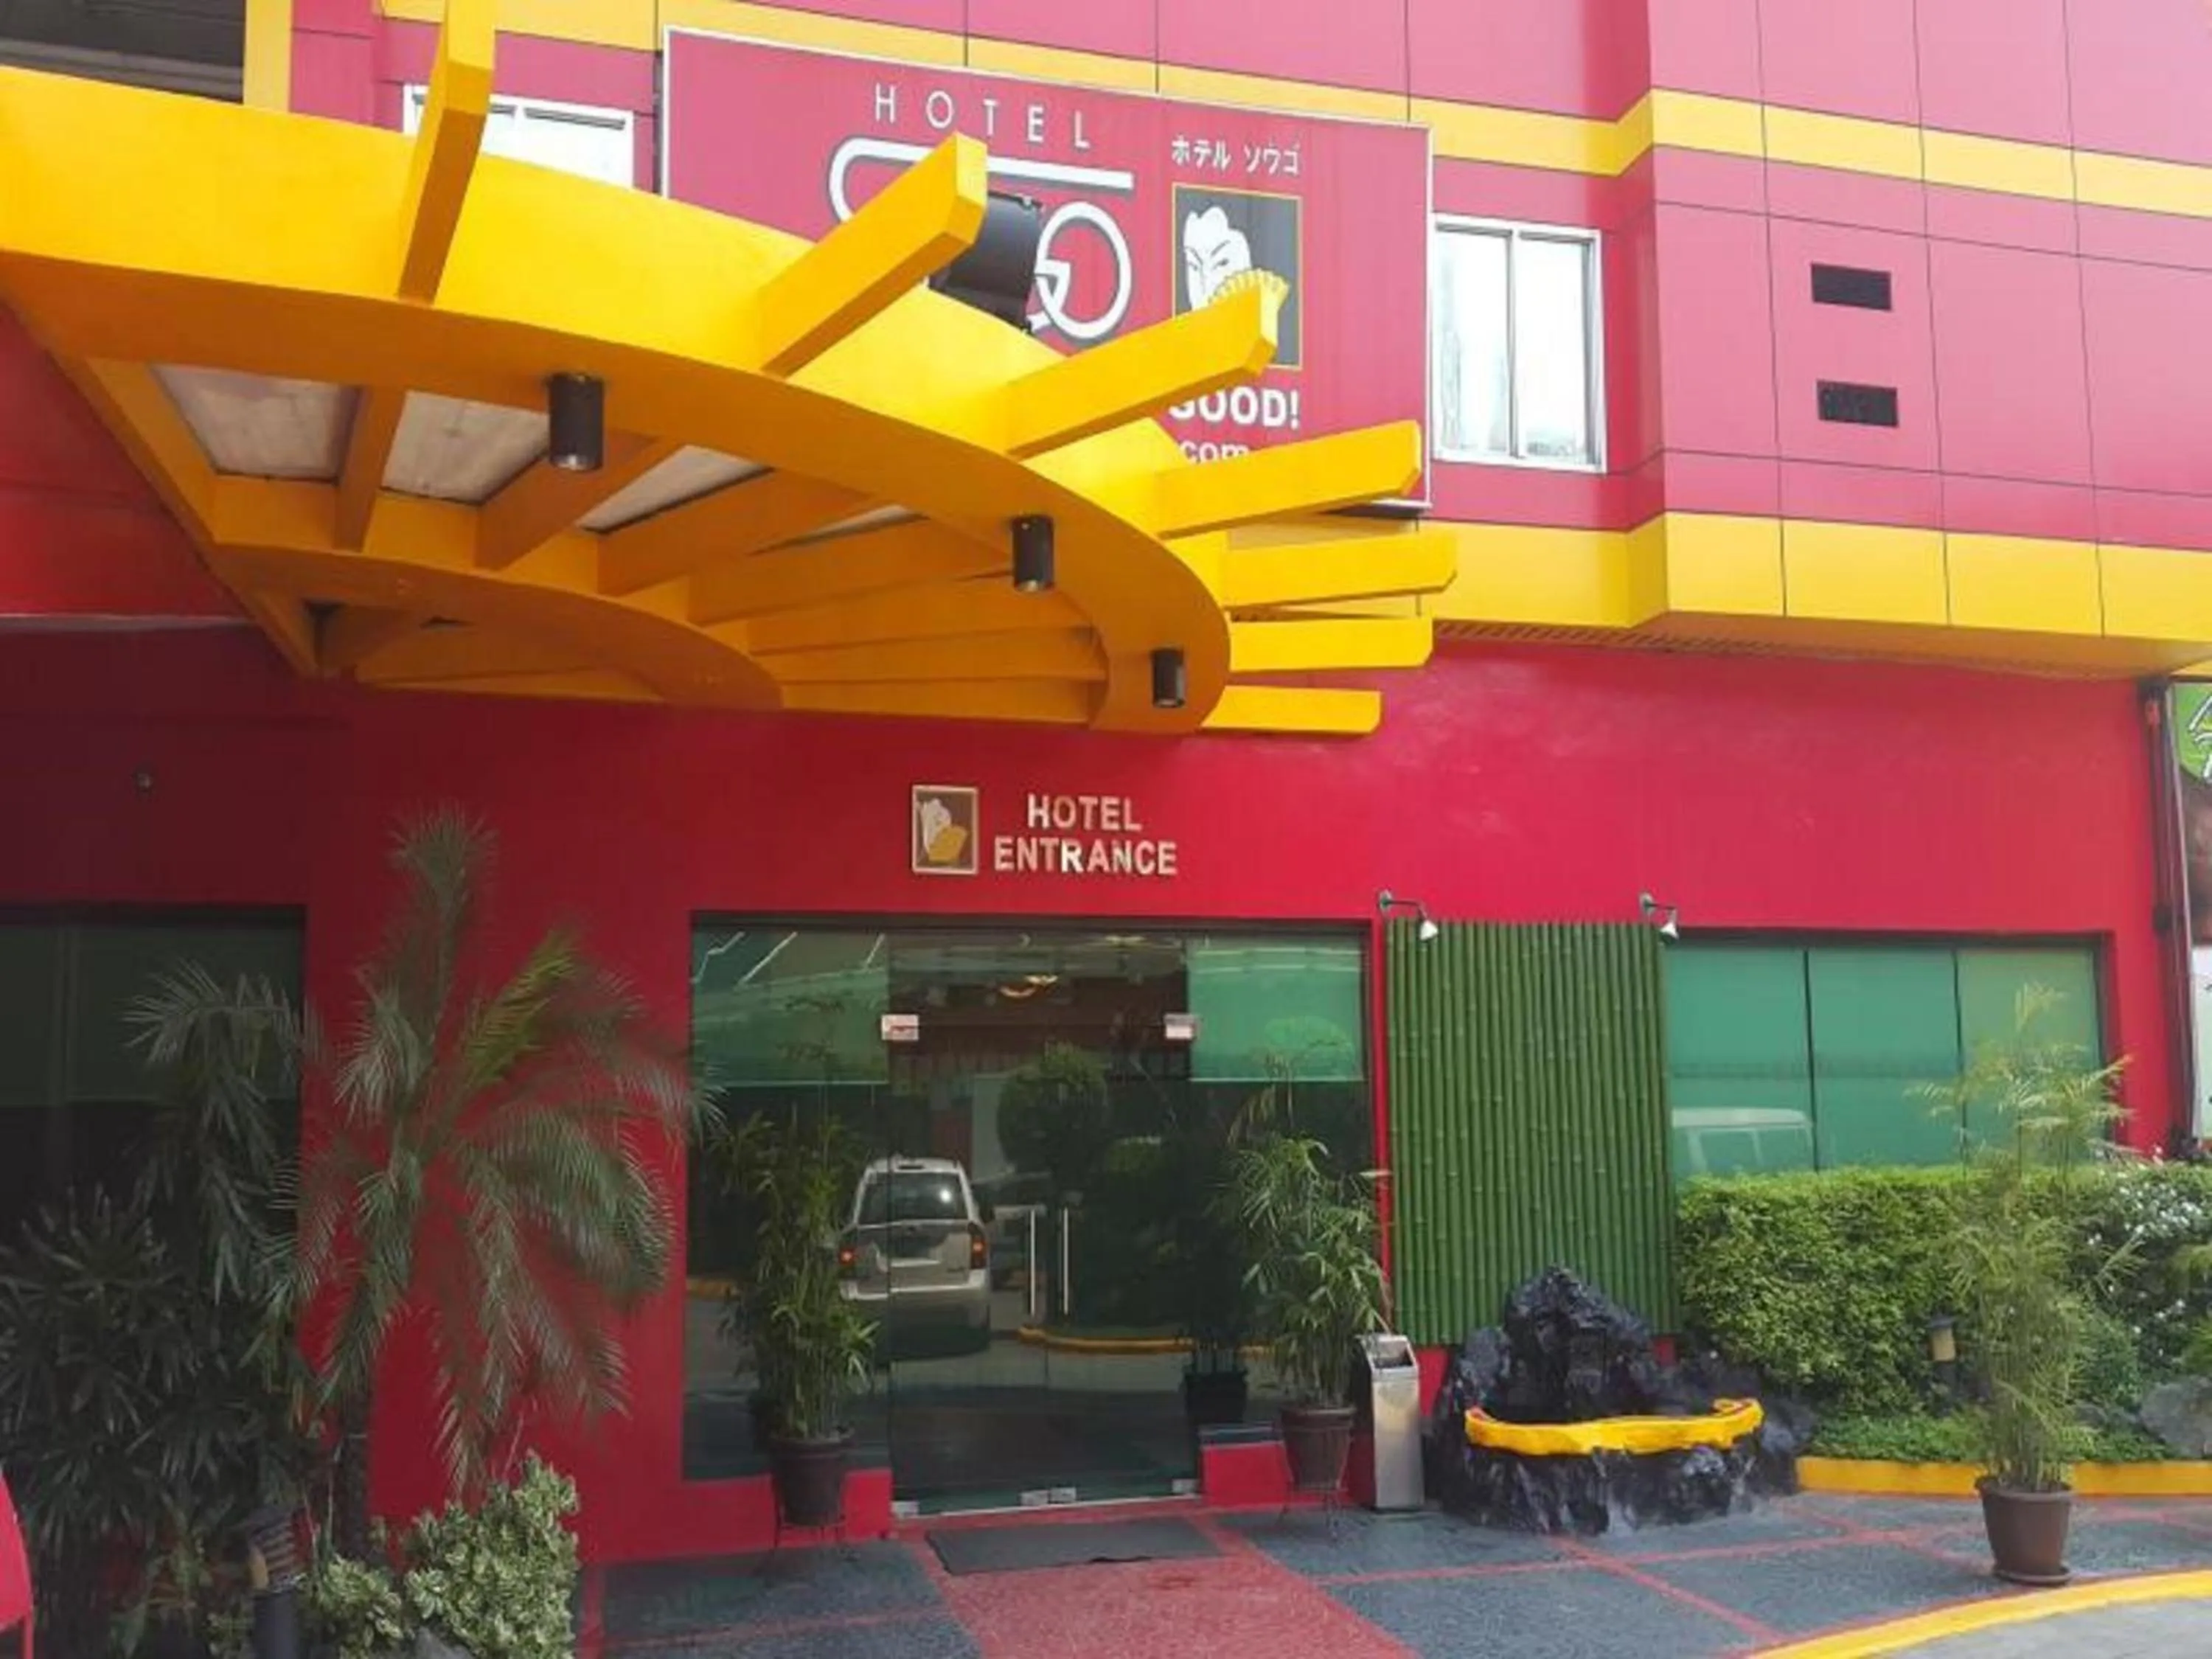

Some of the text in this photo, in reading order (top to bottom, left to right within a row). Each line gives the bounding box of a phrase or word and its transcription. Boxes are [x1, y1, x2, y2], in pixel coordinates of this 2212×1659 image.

[874, 83, 1091, 149] HOTEL
[1171, 133, 1301, 175] ホテル ソウゴ
[1027, 793, 1143, 832] HOTEL
[993, 835, 1179, 876] ENTRANCE
